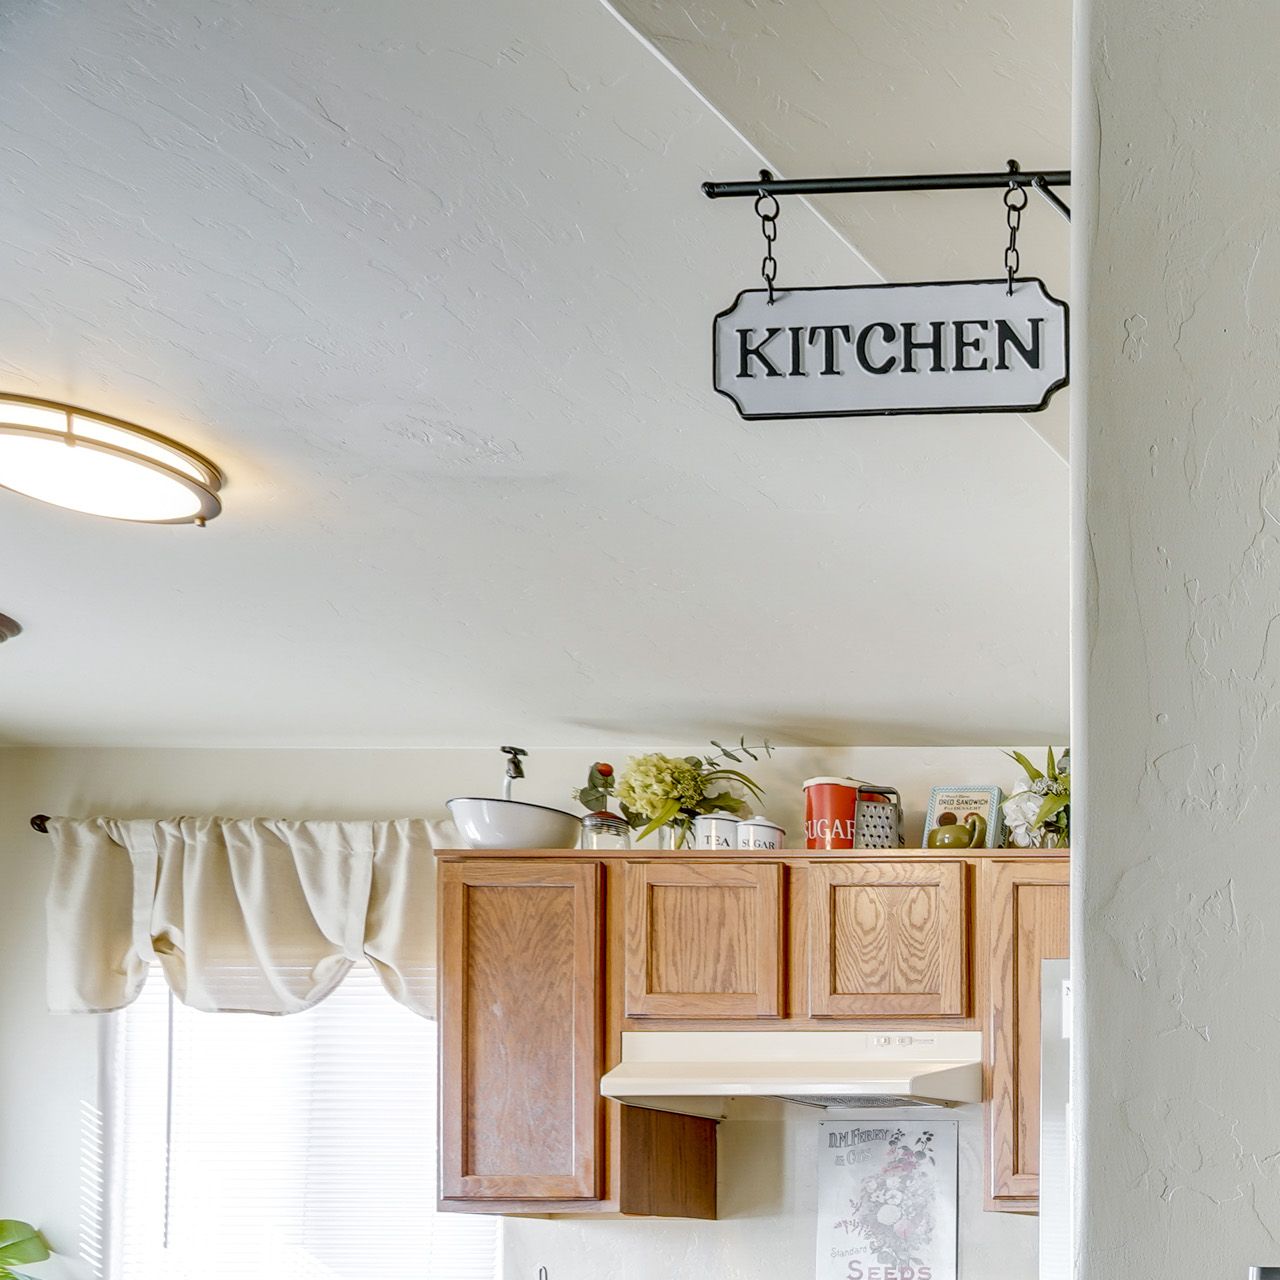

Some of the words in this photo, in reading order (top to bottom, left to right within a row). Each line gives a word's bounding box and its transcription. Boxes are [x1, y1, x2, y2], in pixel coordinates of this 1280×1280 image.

[735, 317, 1045, 379] KITCHEN
[956, 798, 988, 806] SANDWICH
[704, 834, 731, 848] TEA
[741, 838, 775, 850] SUGAR
[830, 1246, 867, 1259] Standard
